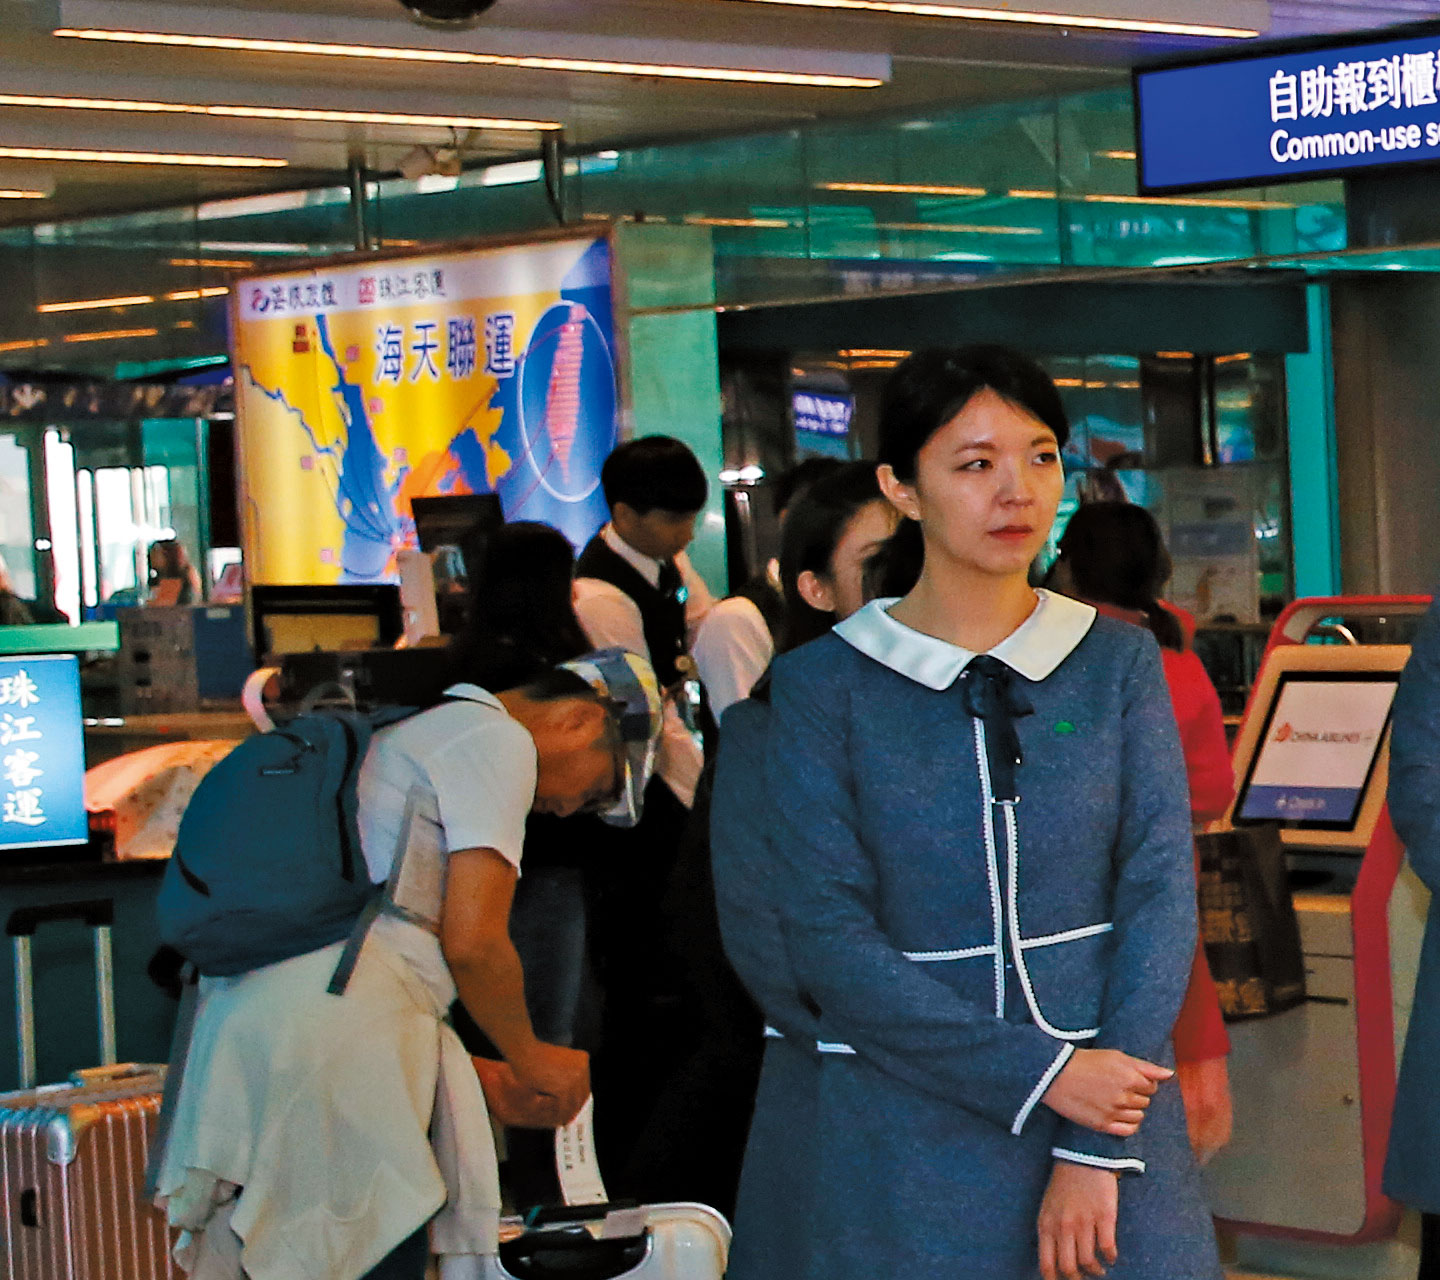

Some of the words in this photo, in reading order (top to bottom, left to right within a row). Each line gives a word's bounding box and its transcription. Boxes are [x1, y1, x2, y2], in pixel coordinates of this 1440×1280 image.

[1270, 125, 1422, 163] Common-use
[376, 314, 515, 383] 海天聯運
[0, 669, 47, 827] 珠江客運
